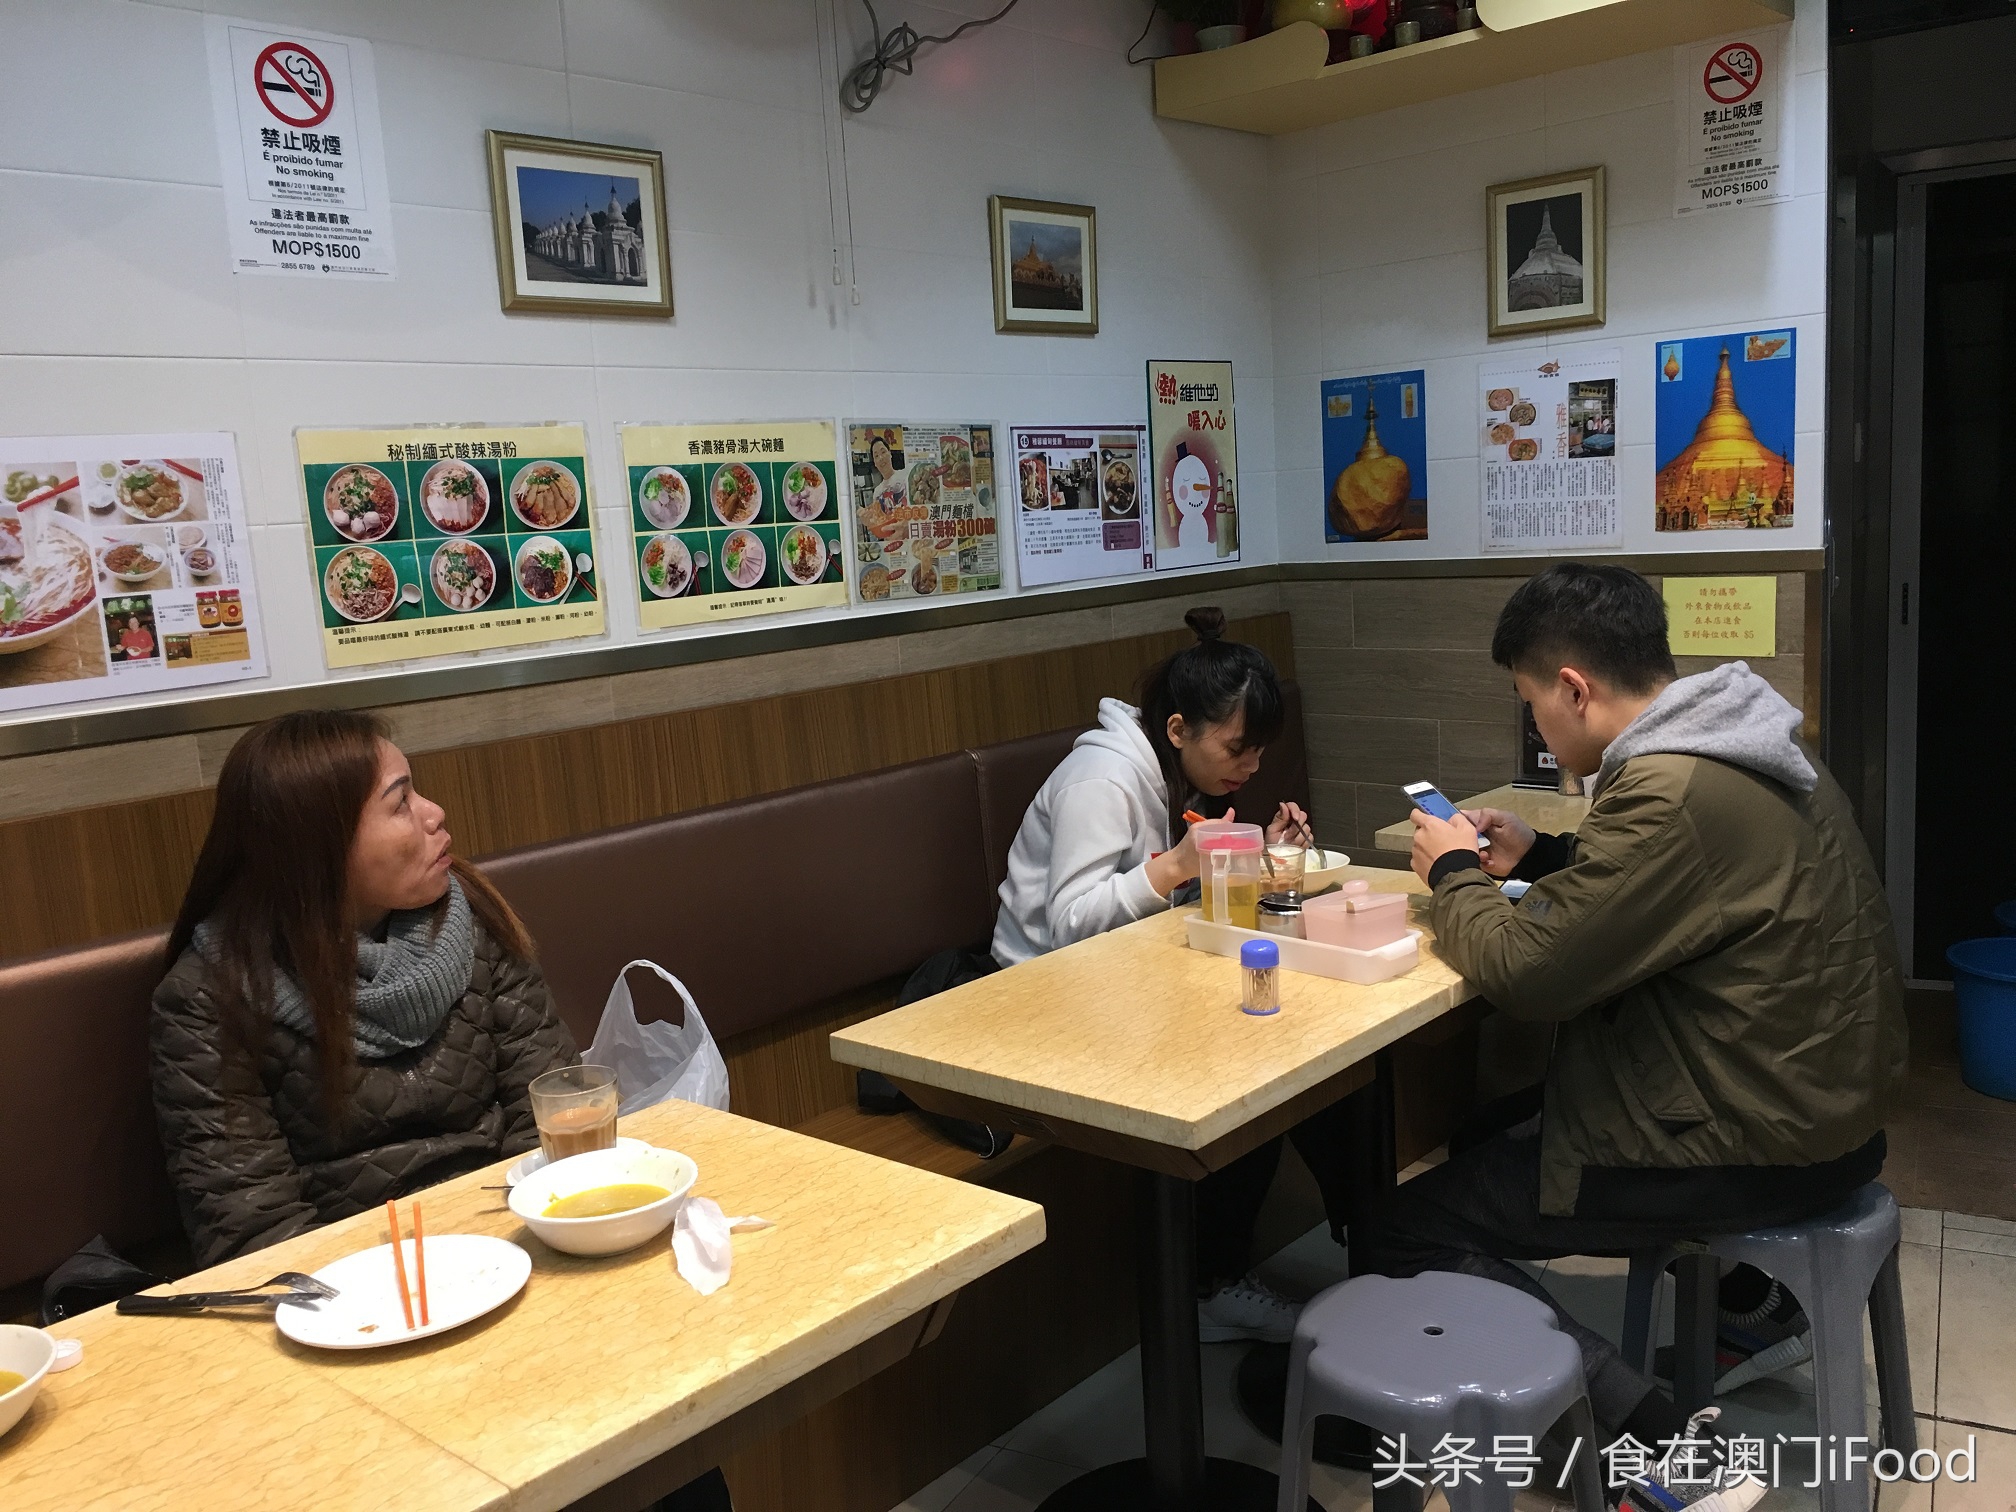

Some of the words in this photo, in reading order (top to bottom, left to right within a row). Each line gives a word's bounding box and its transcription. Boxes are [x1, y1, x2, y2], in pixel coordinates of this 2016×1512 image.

[1703, 101, 1763, 126] 禁止吸煙
[1710, 123, 1739, 135] proibido
[1741, 119, 1763, 128] fumar
[260, 127, 342, 156] 禁止吸煙
[1711, 134, 1722, 142] No
[1723, 129, 1755, 140] smoking
[263, 150, 270, 161] É
[273, 153, 313, 166] proibido
[315, 157, 343, 168] fumar
[276, 165, 290, 175] No
[293, 168, 334, 181] smoking
[1702, 179, 1768, 199] MOP$1500
[271, 208, 350, 225] 違法者最高罰款
[254, 227, 285, 236] Offenders
[297, 230, 314, 239] liable
[329, 234, 357, 242] maximum
[259, 220, 291, 229] infracções
[293, 222, 304, 230] são
[306, 224, 329, 233] punidas
[345, 227, 361, 235] multa
[272, 239, 361, 260] MOP$1500
[281, 262, 297, 270] 2855
[299, 263, 315, 271] 6789
[1187, 410, 1226, 431] 暖入心
[1021, 437, 1029, 447] 15
[387, 441, 517, 461] 秘制緬式酸辣湯粉
[1694, 616, 1742, 625] 在本店進食
[1683, 630, 1739, 639] 否則每位收取
